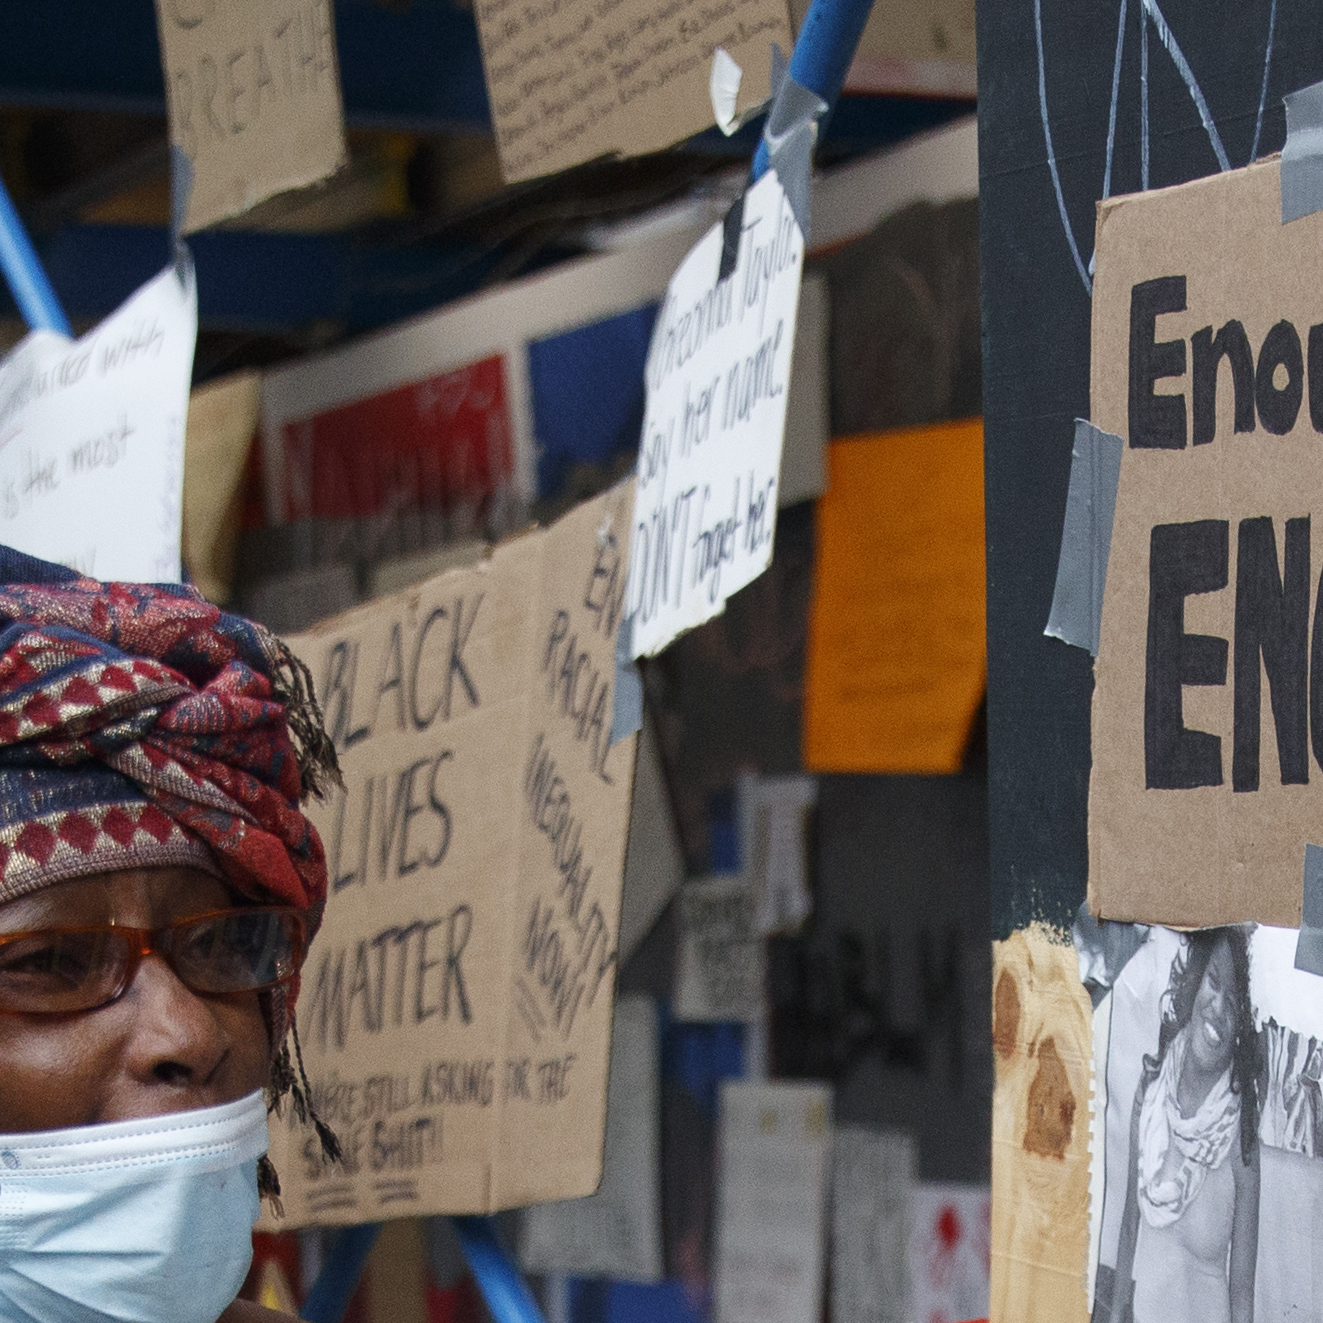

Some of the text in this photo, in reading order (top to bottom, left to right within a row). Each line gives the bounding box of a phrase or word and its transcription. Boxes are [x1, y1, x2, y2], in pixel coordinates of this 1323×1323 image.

[324, 594, 483, 750] BLACK
[541, 608, 617, 788] RACIAL
[330, 748, 455, 894] LIVES
[299, 905, 475, 1056] MATTER
